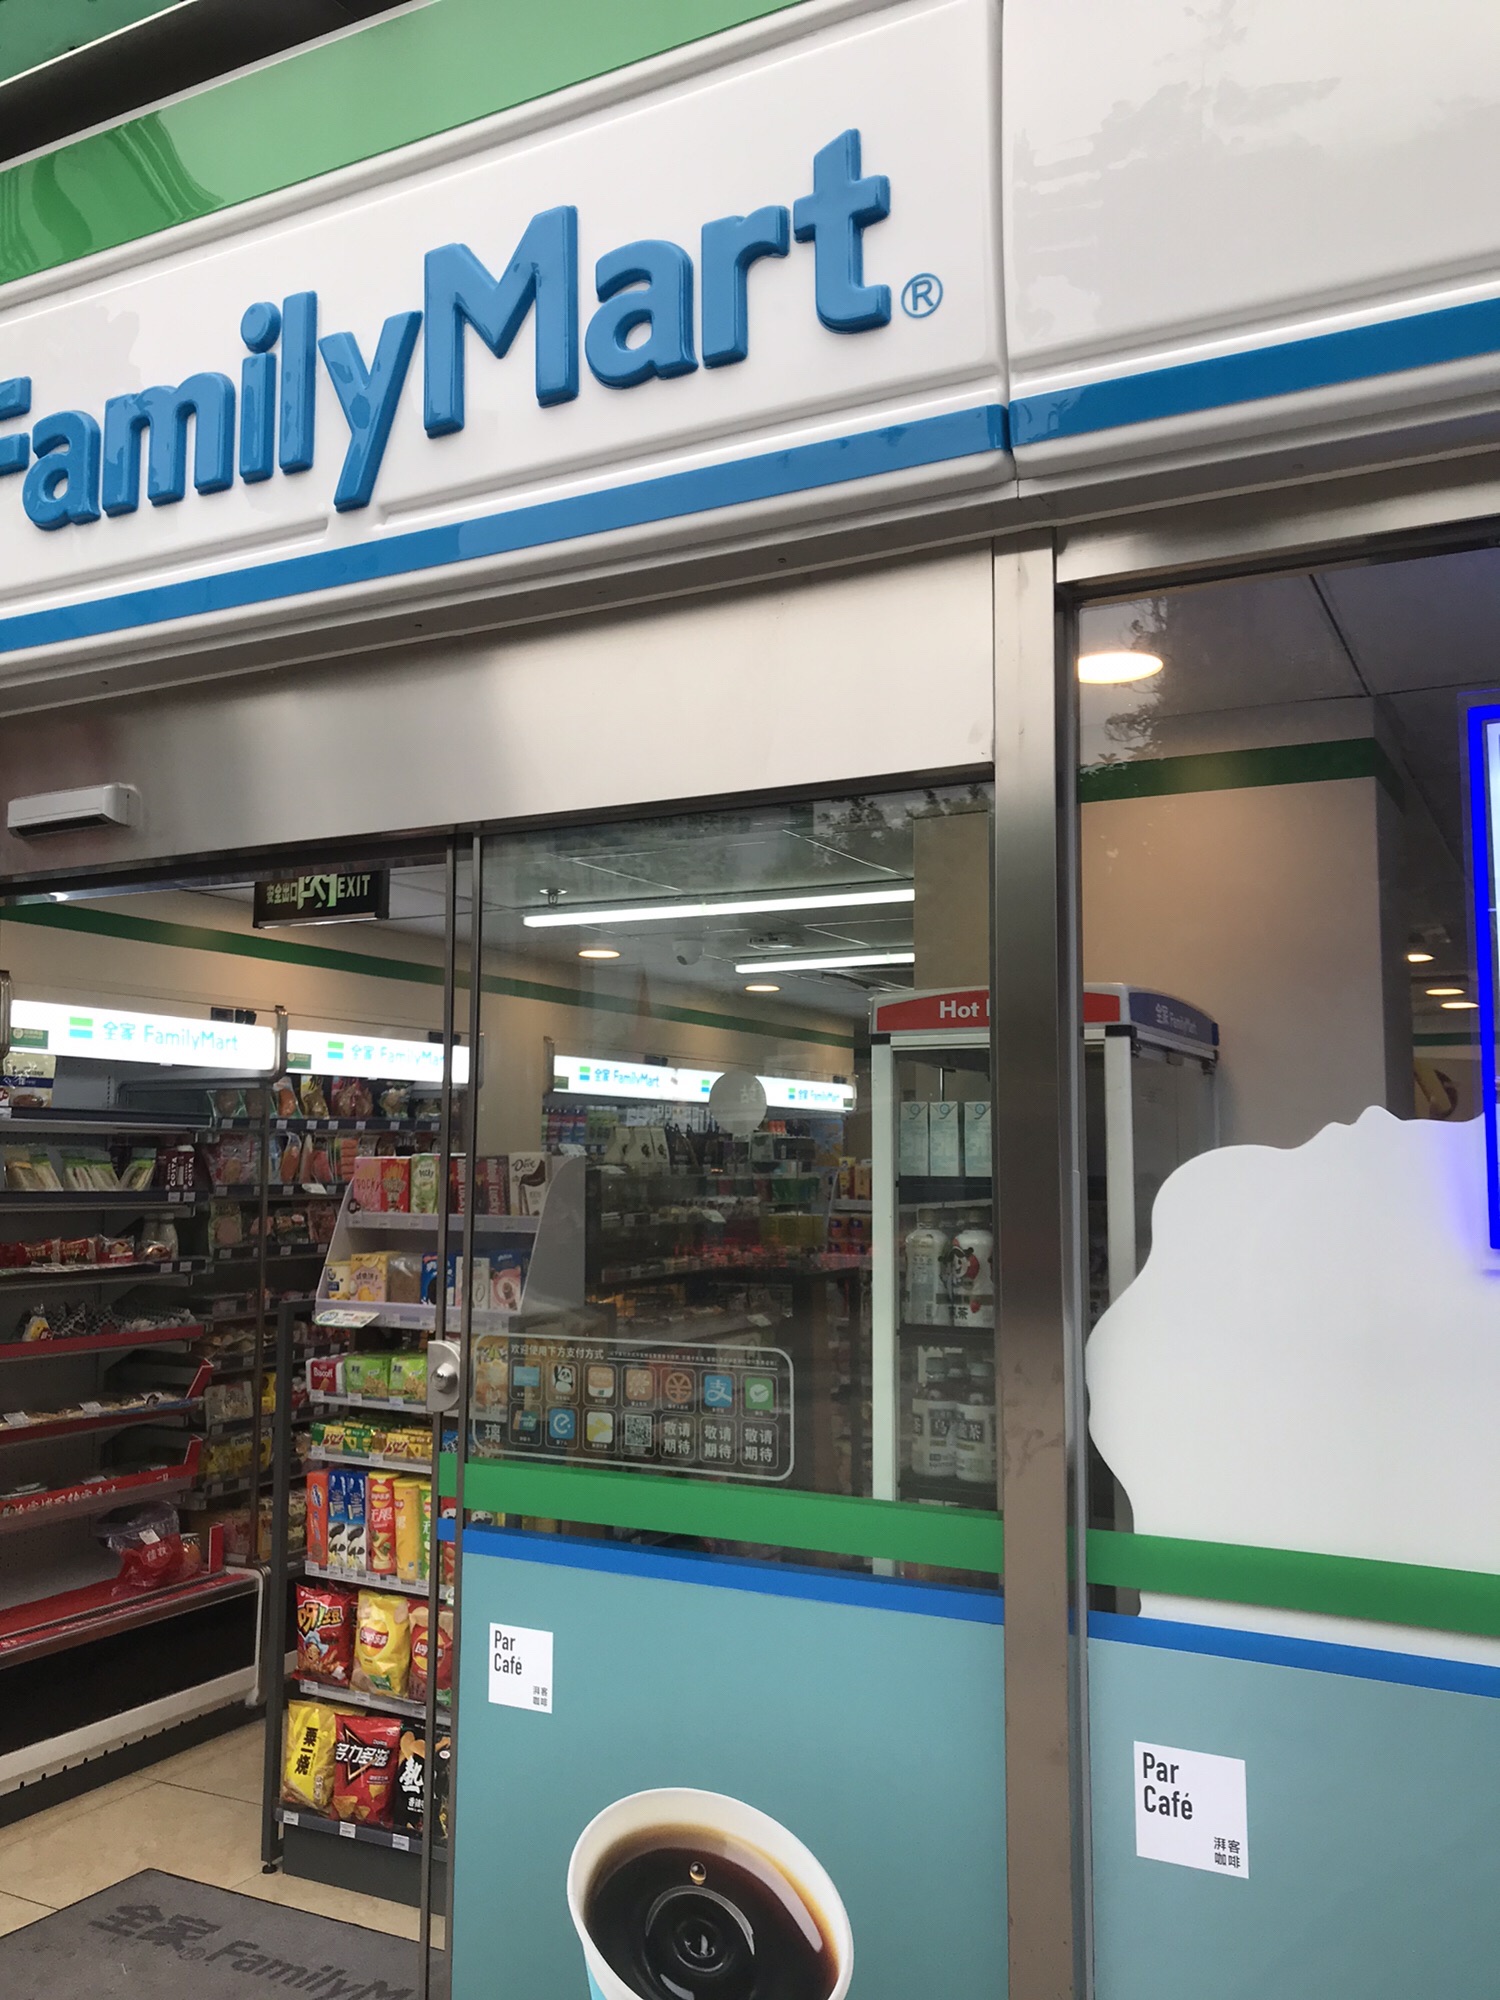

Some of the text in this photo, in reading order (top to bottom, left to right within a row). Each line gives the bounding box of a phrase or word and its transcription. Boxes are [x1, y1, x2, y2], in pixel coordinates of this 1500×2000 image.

[266, 882, 298, 905] 安全出口
[337, 875, 371, 898] EXIT
[939, 1001, 980, 1019] Hot
[103, 1021, 239, 1050] 全家 FamilyMart
[613, 1070, 660, 1088] FamilyMart
[170, 1157, 178, 1187] COSTA
[187, 1157, 195, 1187] COSTA
[511, 1344, 604, 1360] 欢迎使用下方支付方式
[664, 1421, 691, 1437] 敬请
[704, 1425, 731, 1442] 敬请
[745, 1428, 773, 1445] 敬请
[664, 1438, 691, 1455] 期待
[704, 1443, 731, 1459] 期待
[745, 1446, 773, 1463] 期待
[494, 1629, 516, 1651] Par
[494, 1652, 522, 1676] Café
[533, 1696, 548, 1707] 咖啡
[335, 1742, 390, 1767] 多力多滋
[1143, 1751, 1180, 1784] Par
[1144, 1785, 1193, 1820] Café
[1214, 1836, 1241, 1854] 湃客
[1214, 1852, 1241, 1869] 咖啡
[88, 1904, 222, 1952] 全家
